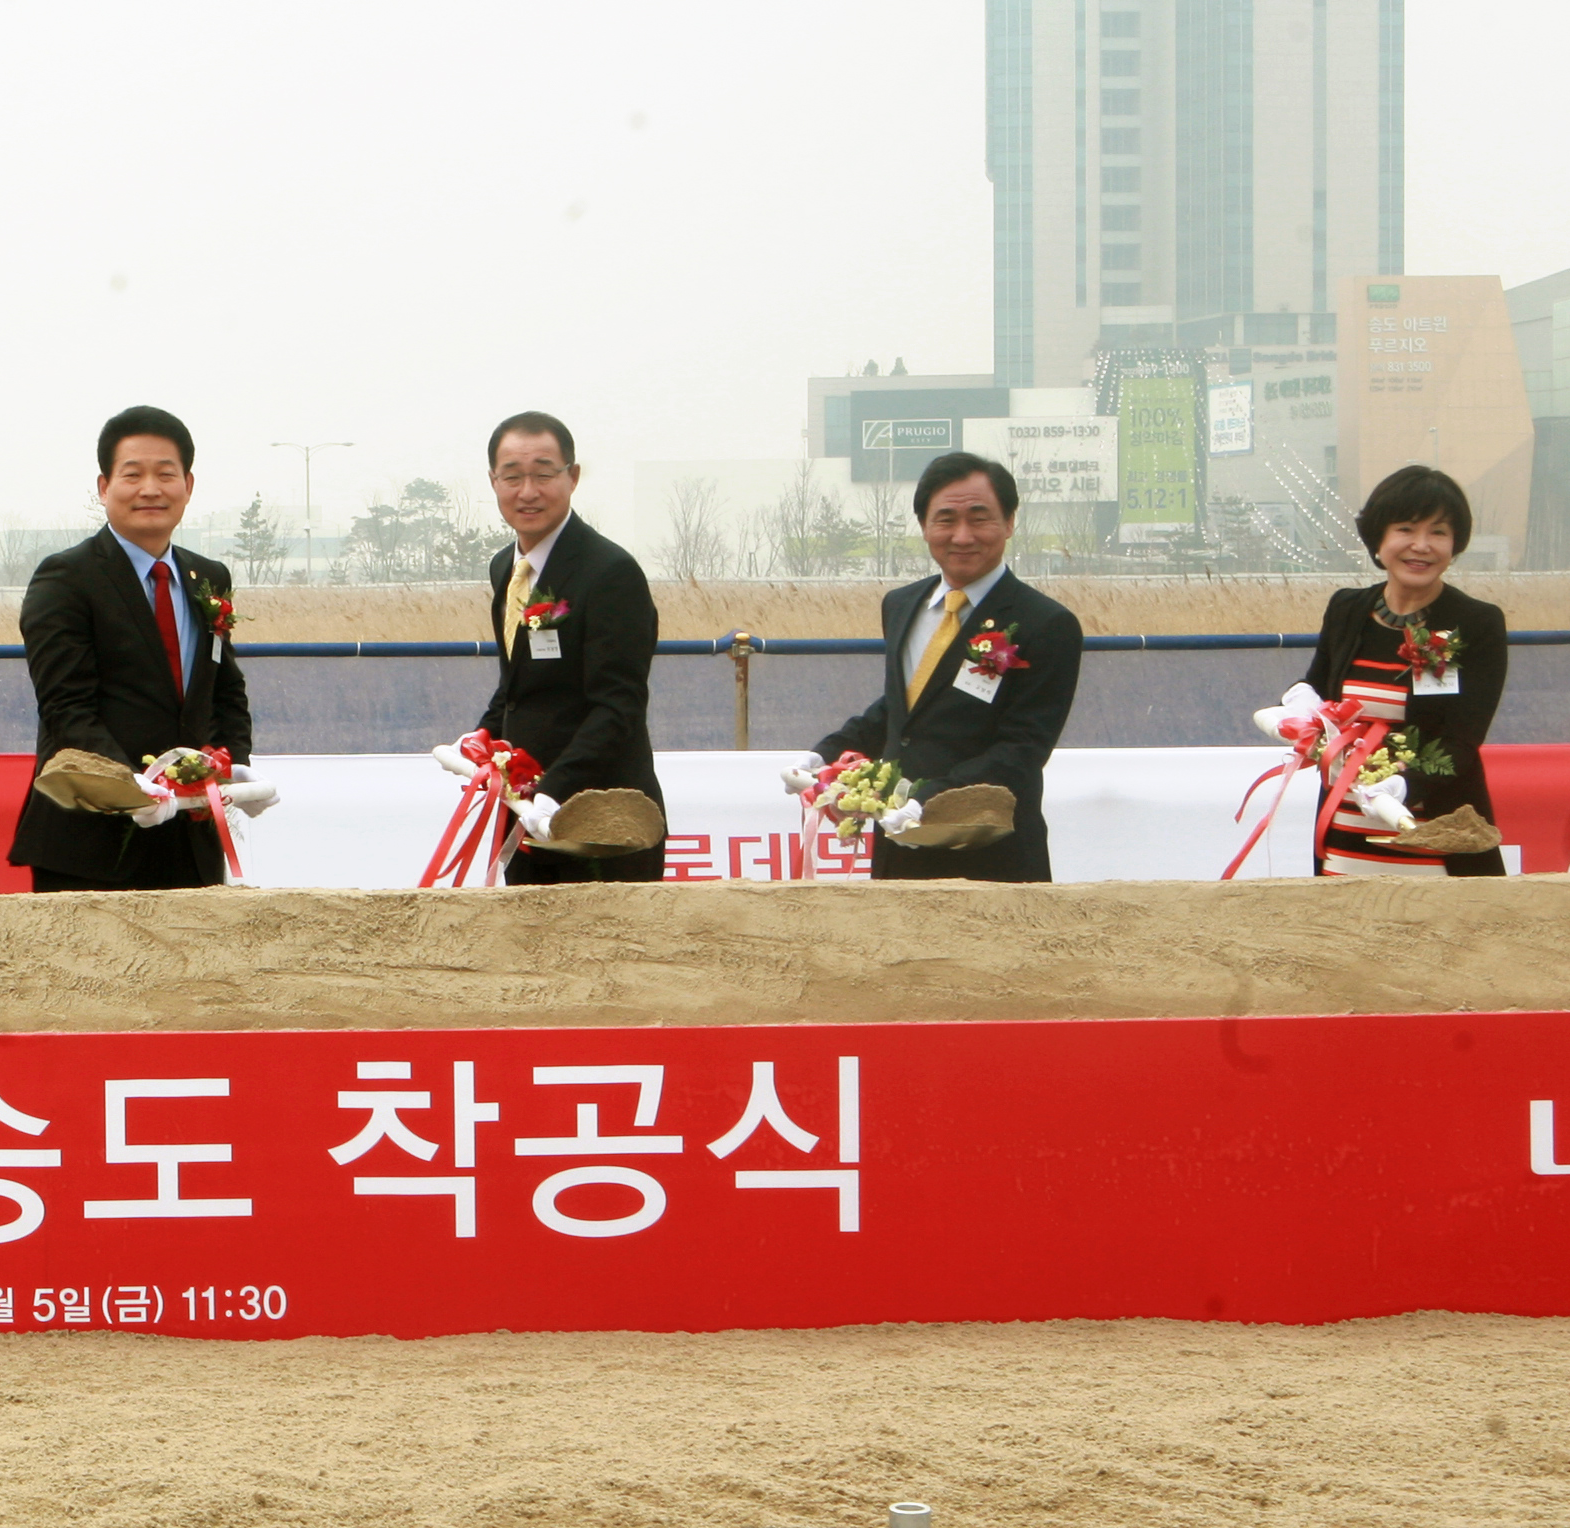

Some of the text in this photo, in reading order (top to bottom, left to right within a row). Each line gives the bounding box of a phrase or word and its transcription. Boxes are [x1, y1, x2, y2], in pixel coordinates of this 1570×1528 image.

[1368, 315, 1447, 333] 송도 아트윈
[1368, 337, 1428, 353] 푸르지오
[1131, 408, 1184, 427] 100%
[897, 427, 946, 436] PRUGIO
[1070, 476, 1100, 494] 시티
[1127, 488, 1186, 509] 5.12:1
[327, 1056, 861, 1239] 착공식
[33, 1286, 165, 1326] 5일(금)
[181, 1286, 288, 1322] 11:30
